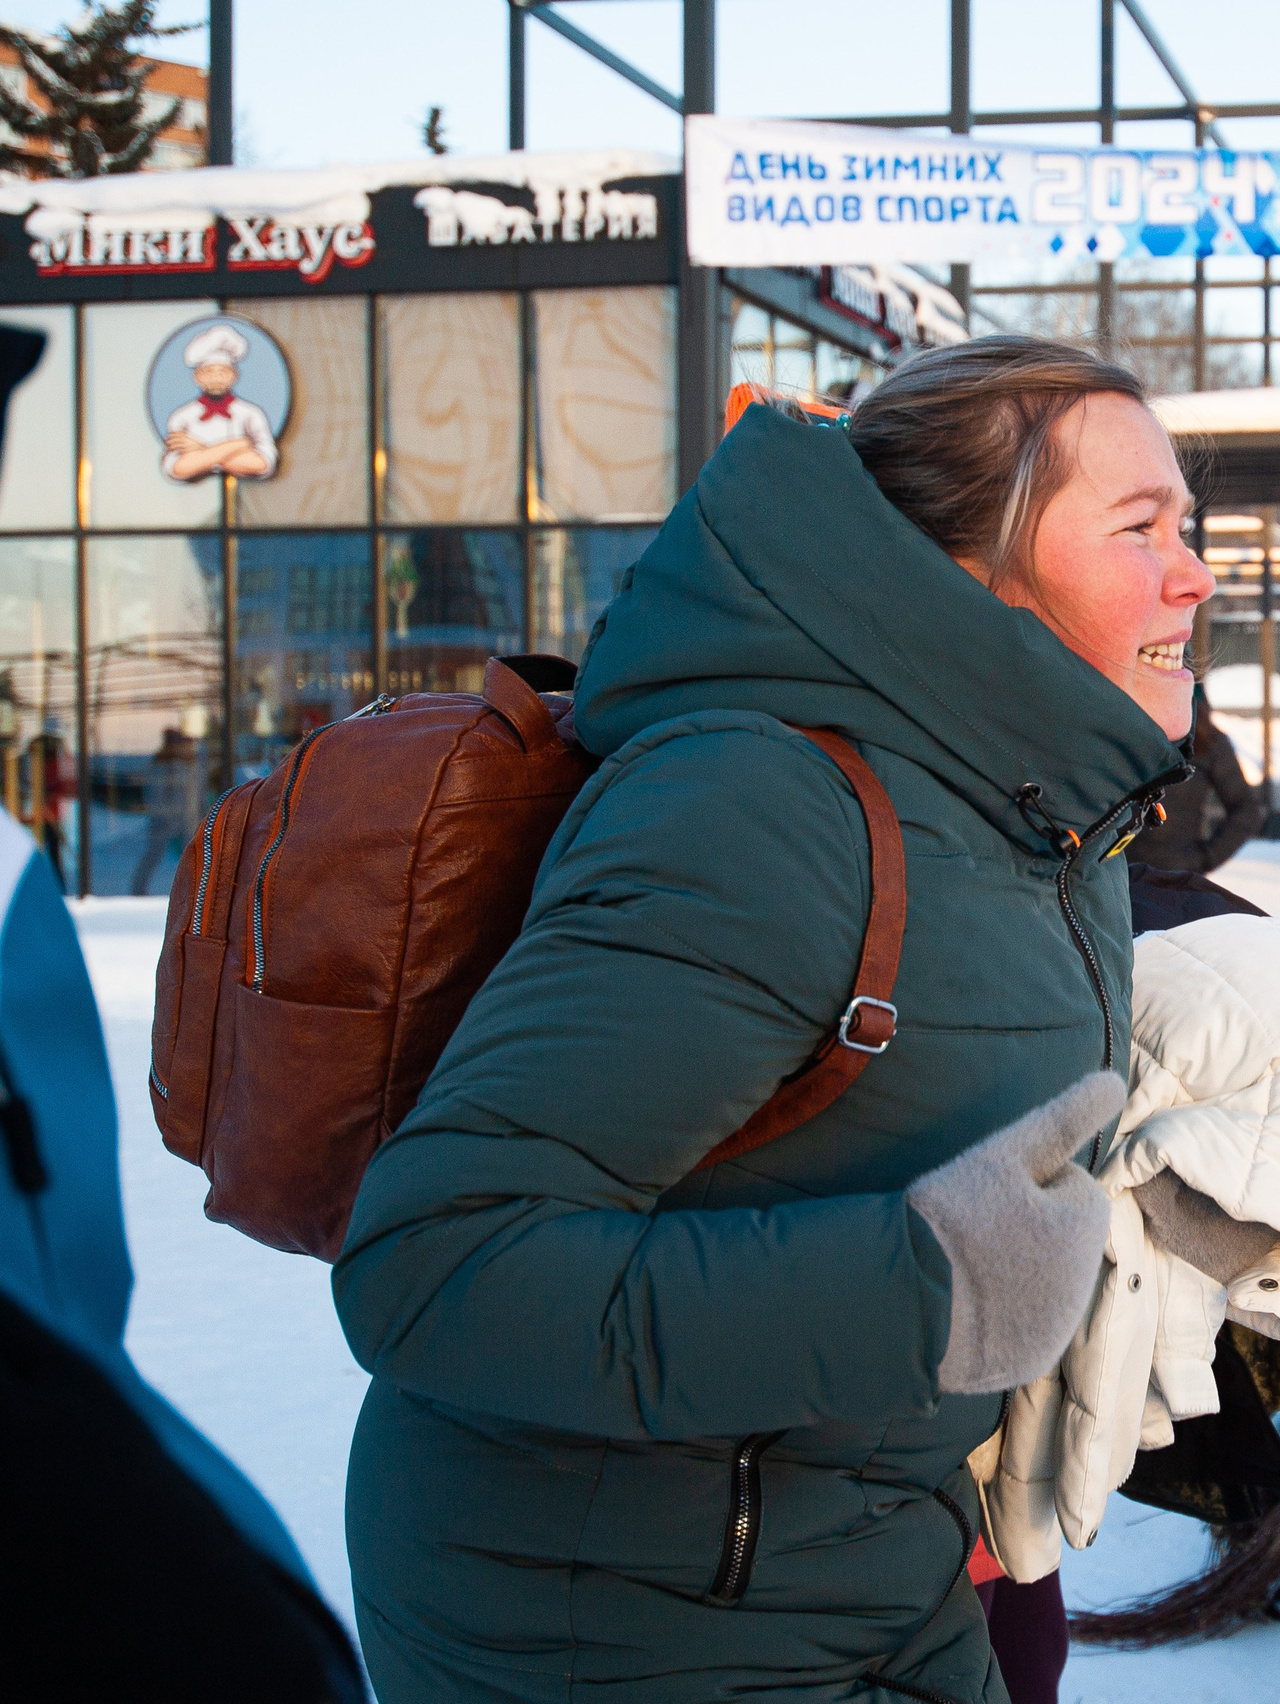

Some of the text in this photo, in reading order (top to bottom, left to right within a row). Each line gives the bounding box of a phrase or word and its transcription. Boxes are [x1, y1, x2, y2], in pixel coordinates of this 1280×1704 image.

[726, 151, 1003, 184] ДЕНЬ ЗИМНИХ
[1031, 152, 1256, 224] 2024
[426, 203, 658, 247] ШАТЕРИЯ
[727, 195, 1019, 226] ВИДОВ СПОРТА
[29, 217, 374, 279] Мики Хаус
